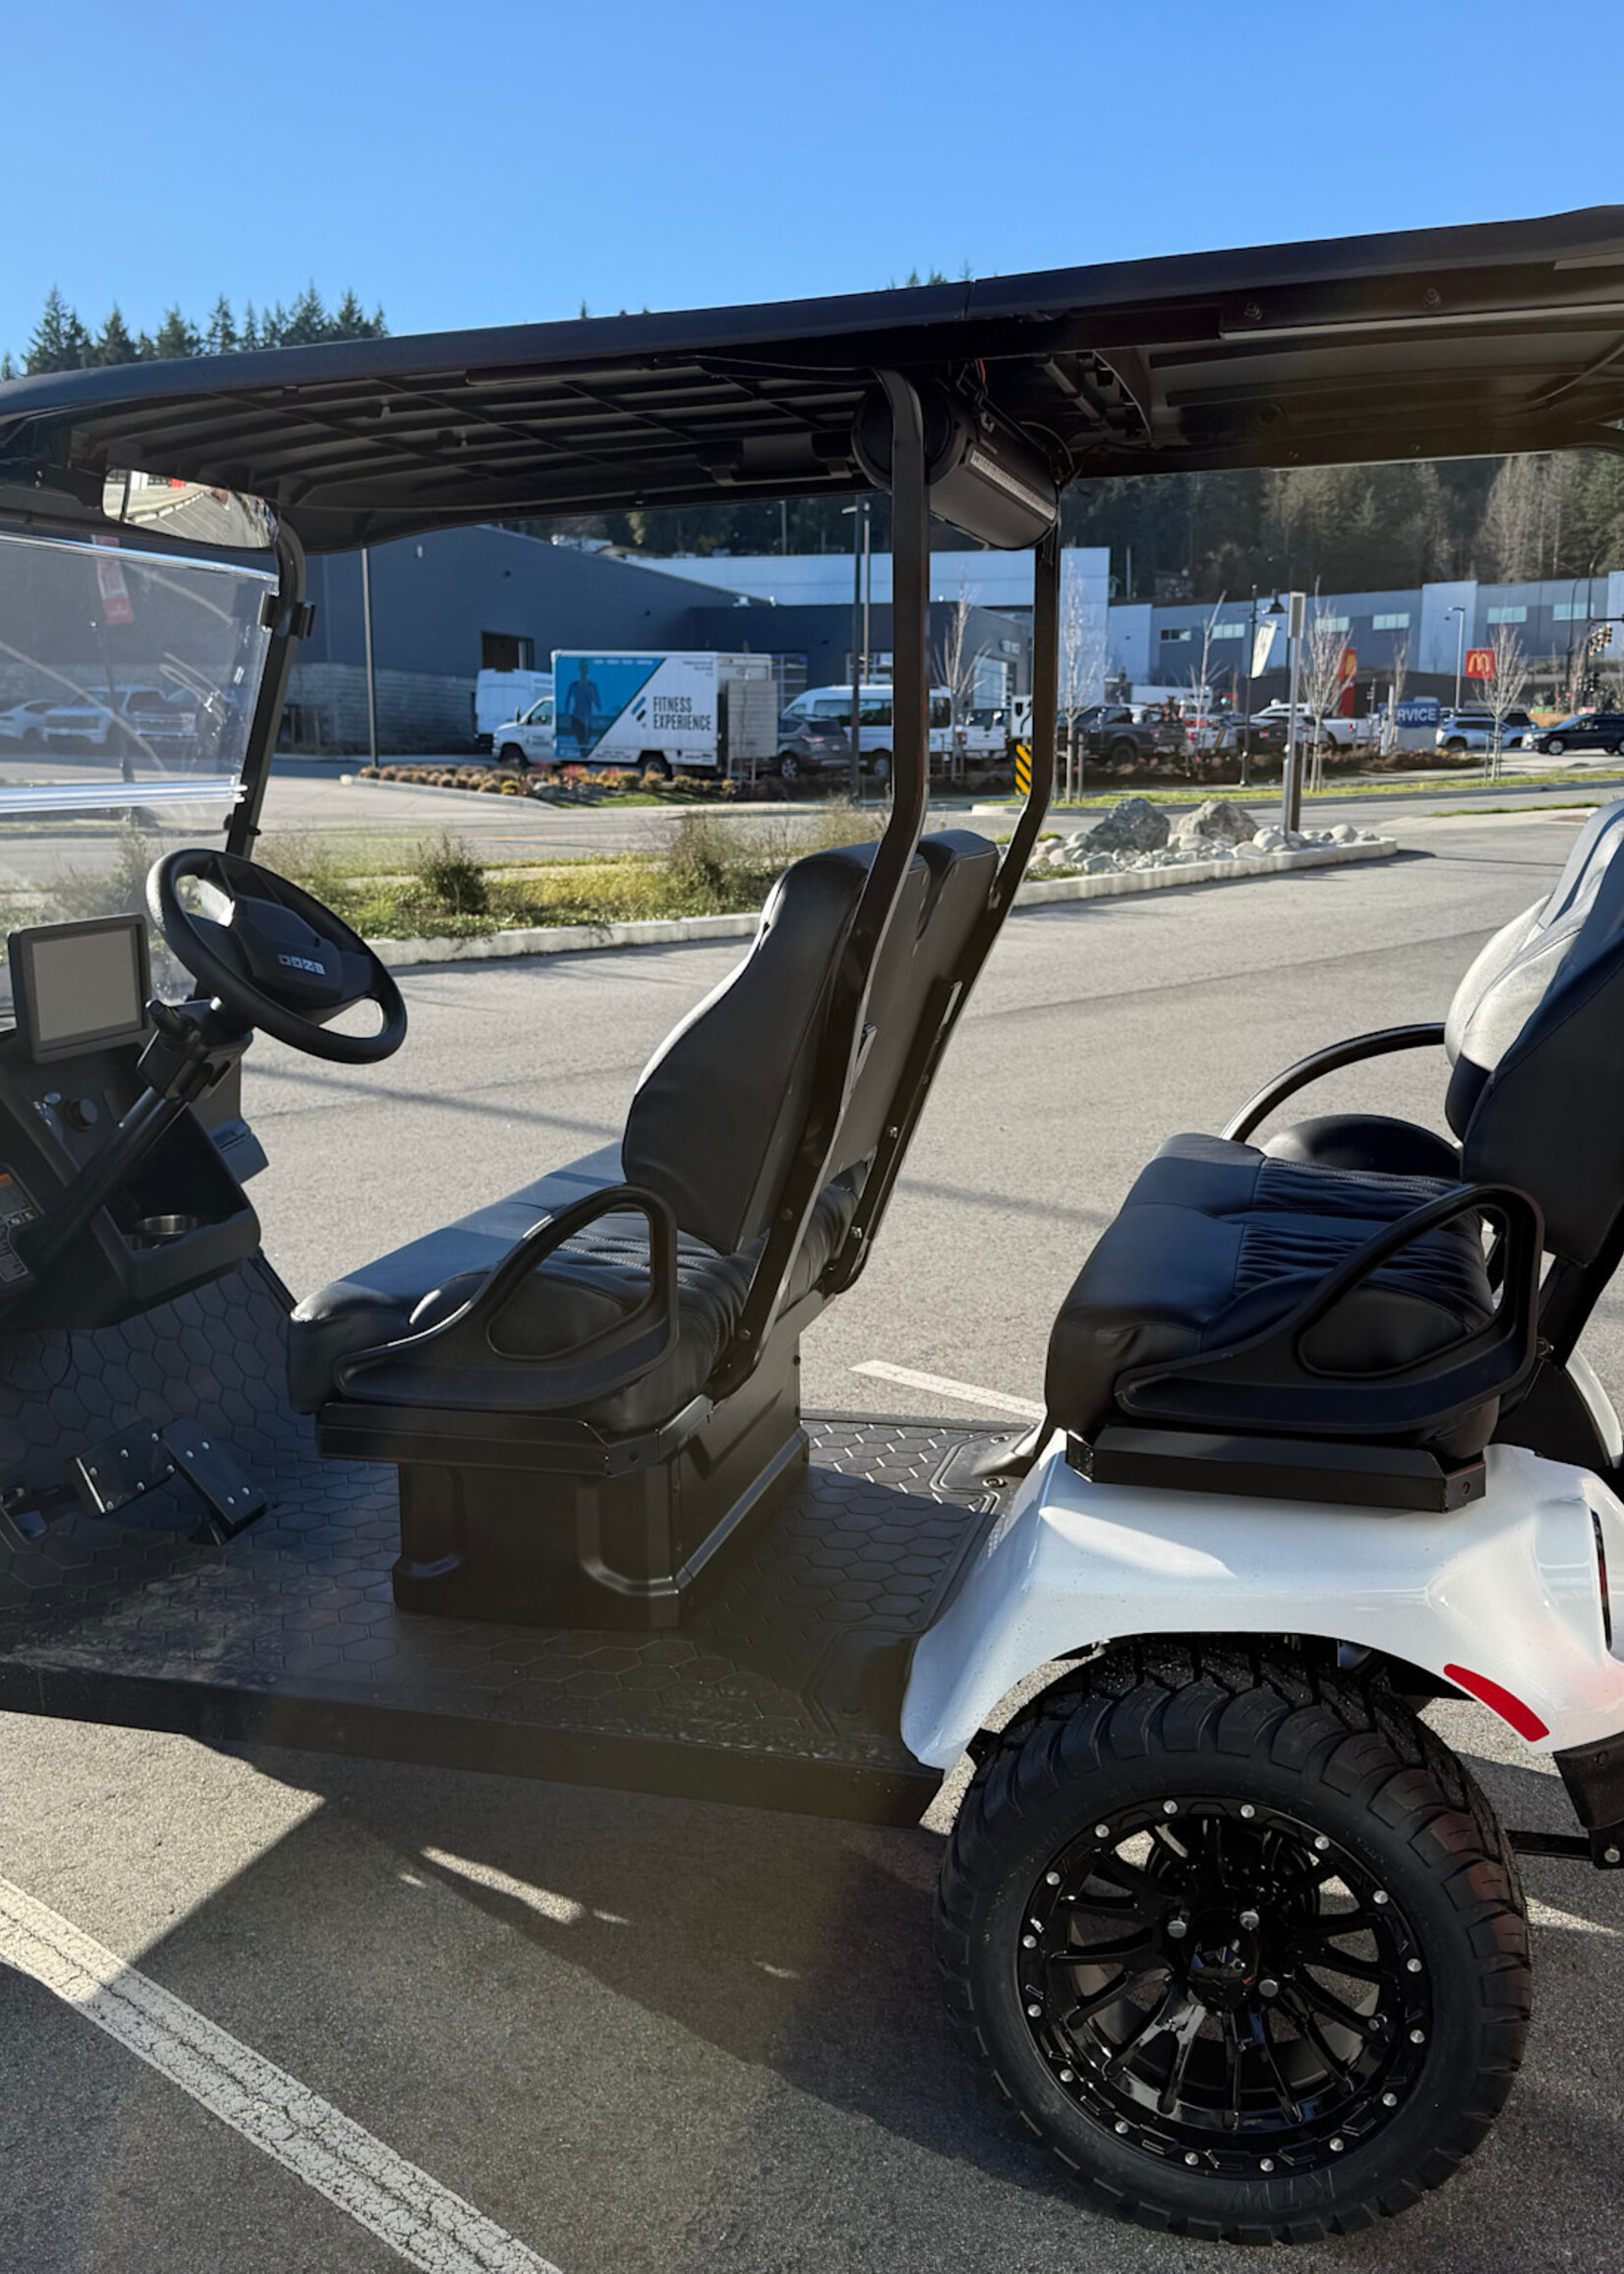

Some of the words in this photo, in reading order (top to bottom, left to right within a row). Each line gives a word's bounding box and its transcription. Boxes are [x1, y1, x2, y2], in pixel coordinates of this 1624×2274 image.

[654, 697, 692, 713] FITNESS
[654, 714, 712, 730] EXPERIENCE
[1396, 708, 1437, 722] RVICE
